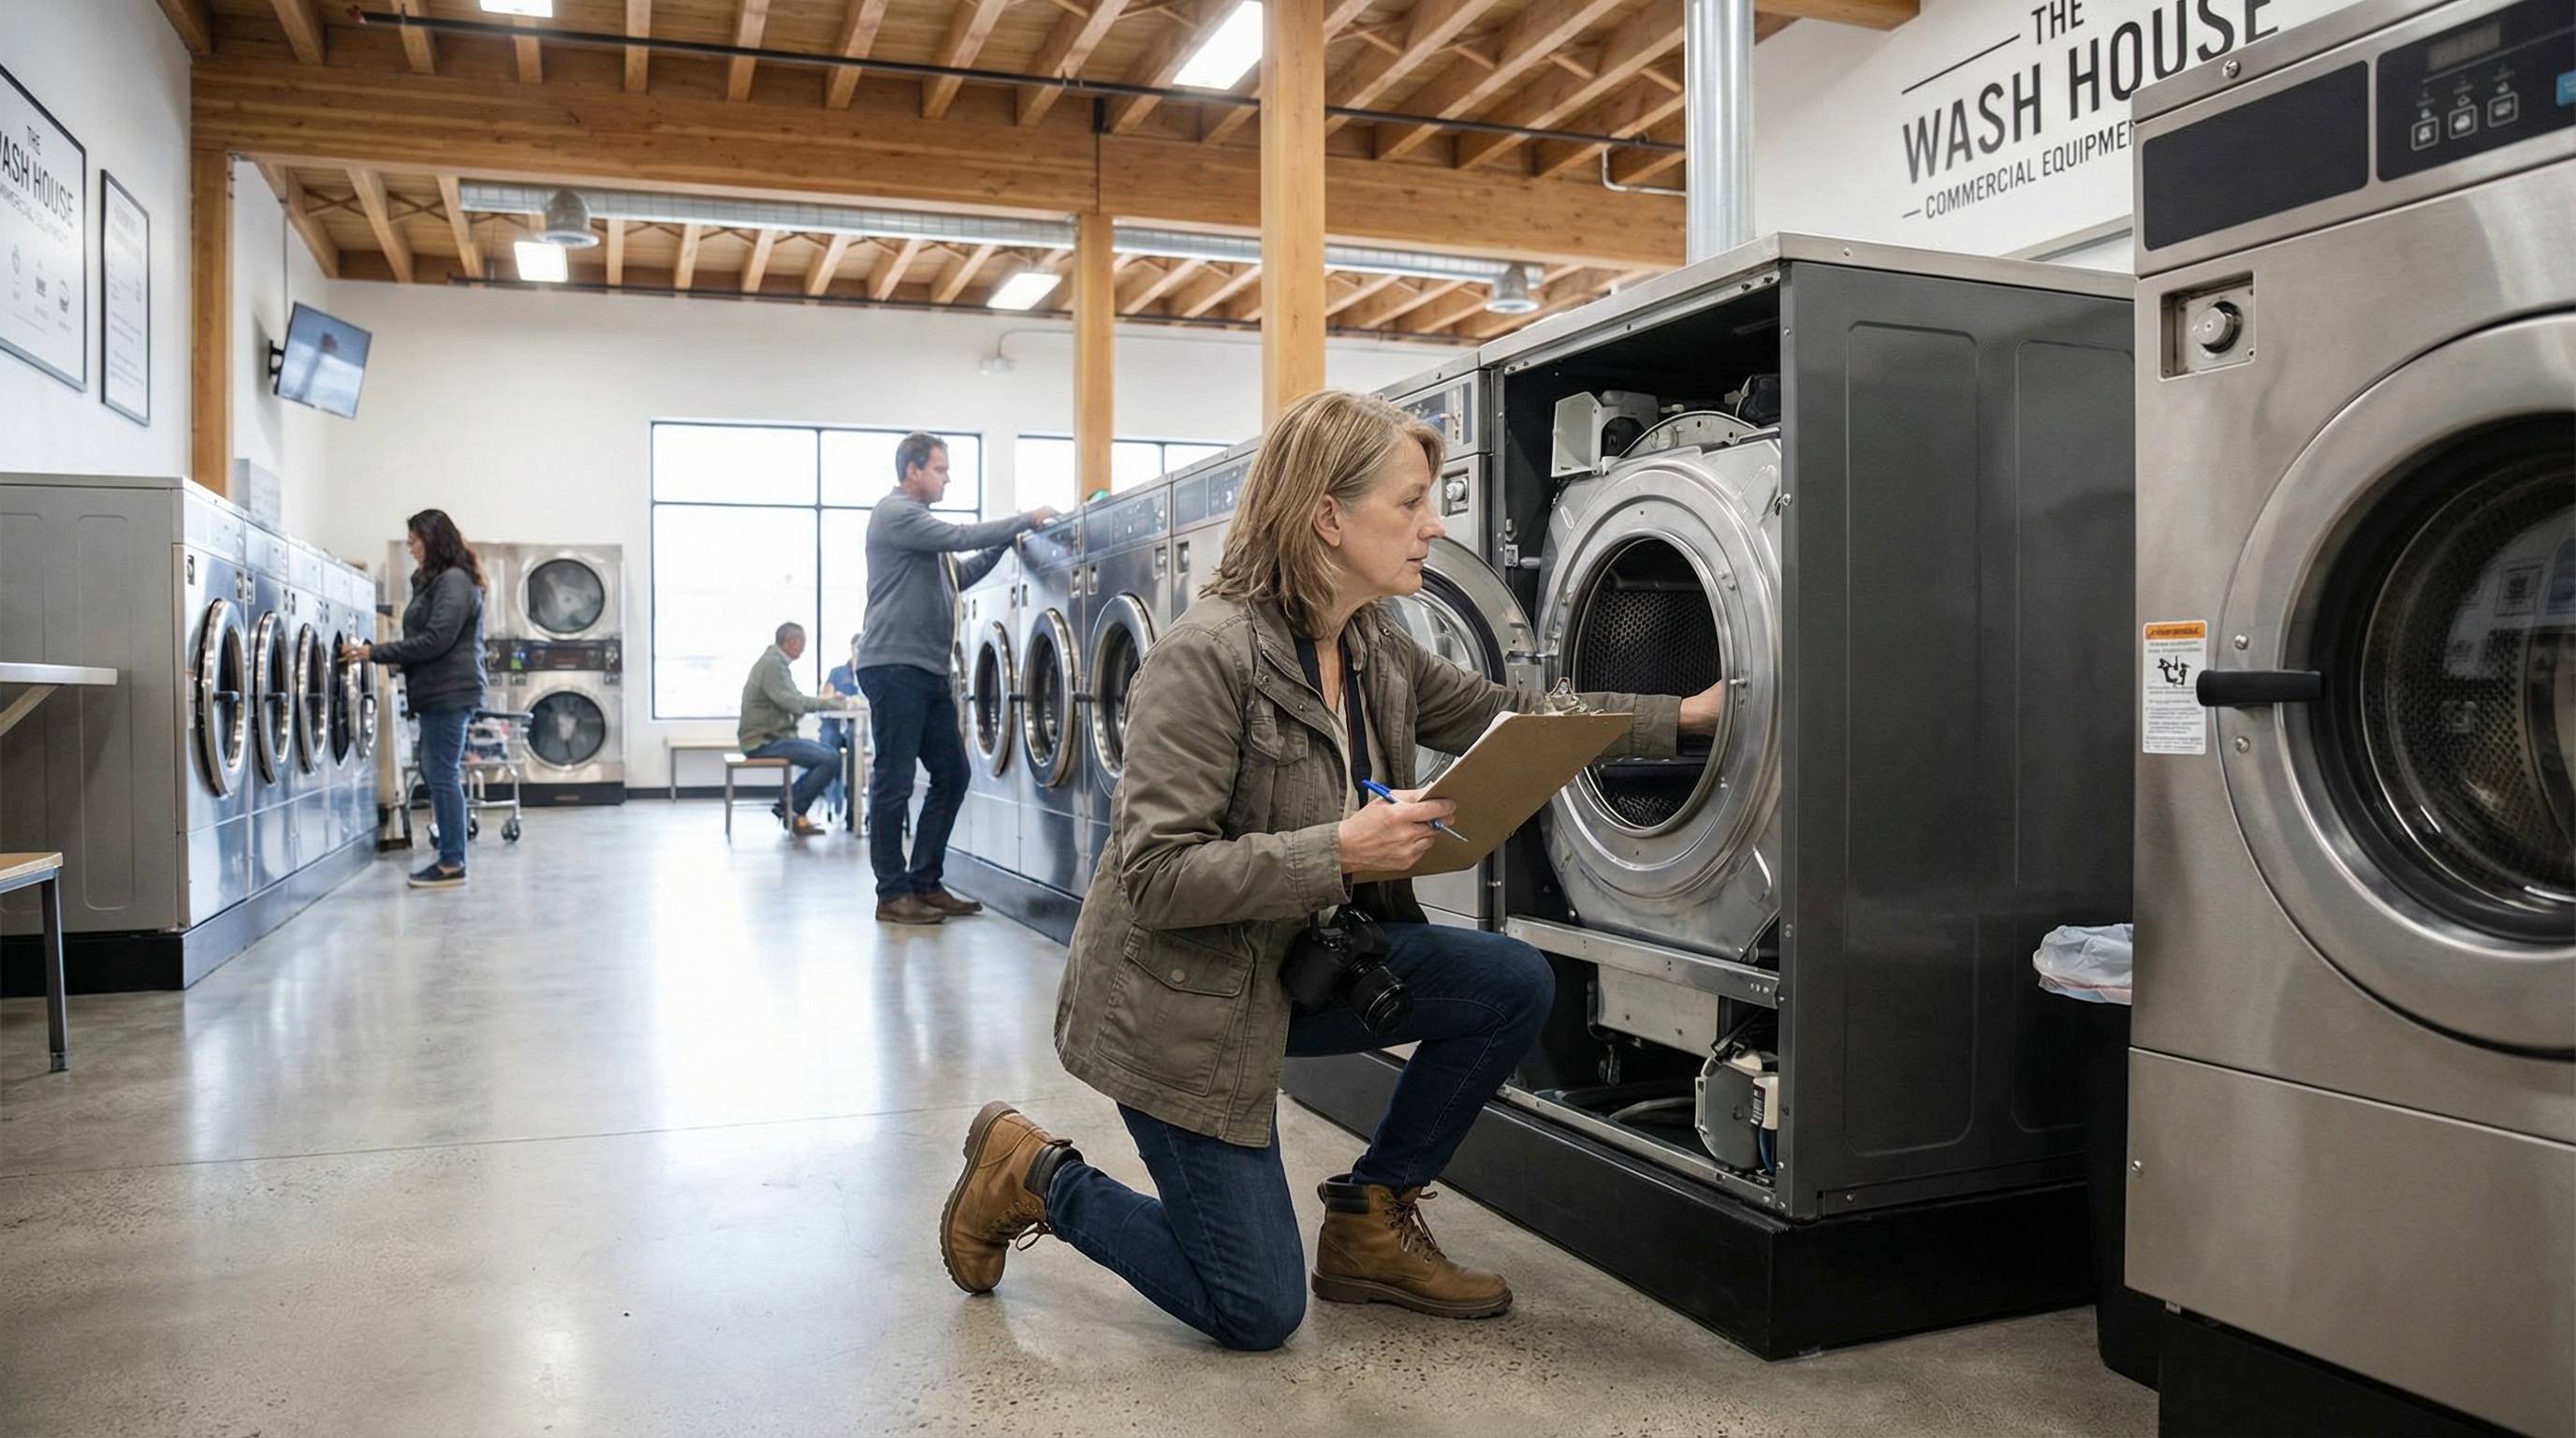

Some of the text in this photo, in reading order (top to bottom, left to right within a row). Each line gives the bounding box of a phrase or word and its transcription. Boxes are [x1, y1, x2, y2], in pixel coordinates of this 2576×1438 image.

[2030, 0, 2085, 45] THE
[1902, 62, 2042, 184] WASH
[0, 129, 30, 192] ASH
[33, 160, 74, 229] HOUSE
[1925, 158, 2037, 219] COMMERCIAL
